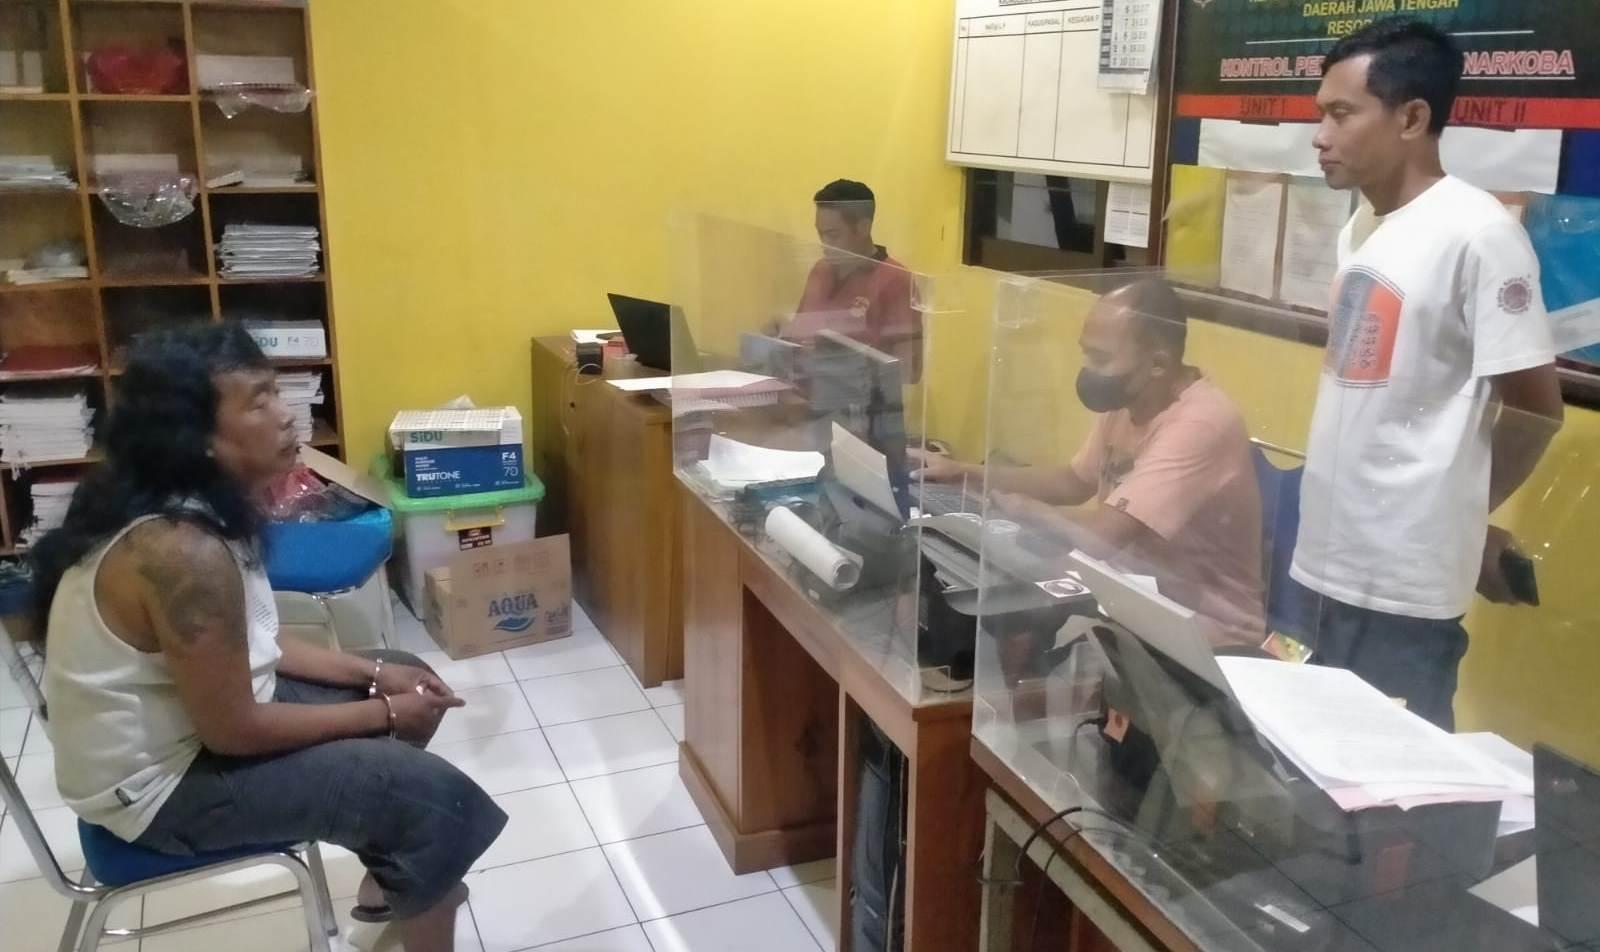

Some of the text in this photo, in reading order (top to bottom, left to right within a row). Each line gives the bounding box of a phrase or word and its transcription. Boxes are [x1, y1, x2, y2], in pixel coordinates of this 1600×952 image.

[1303, 0, 1460, 17] DAERAH JAWA TENGAH
[1220, 57, 1293, 77] KONTROL
[1462, 50, 1575, 75] NARKOBA
[1240, 98, 1277, 116] UNIT
[1454, 99, 1527, 123] UNIT II
[501, 451, 517, 461] F4
[415, 470, 461, 482] TRUTONE
[488, 592, 539, 618] AQUA
